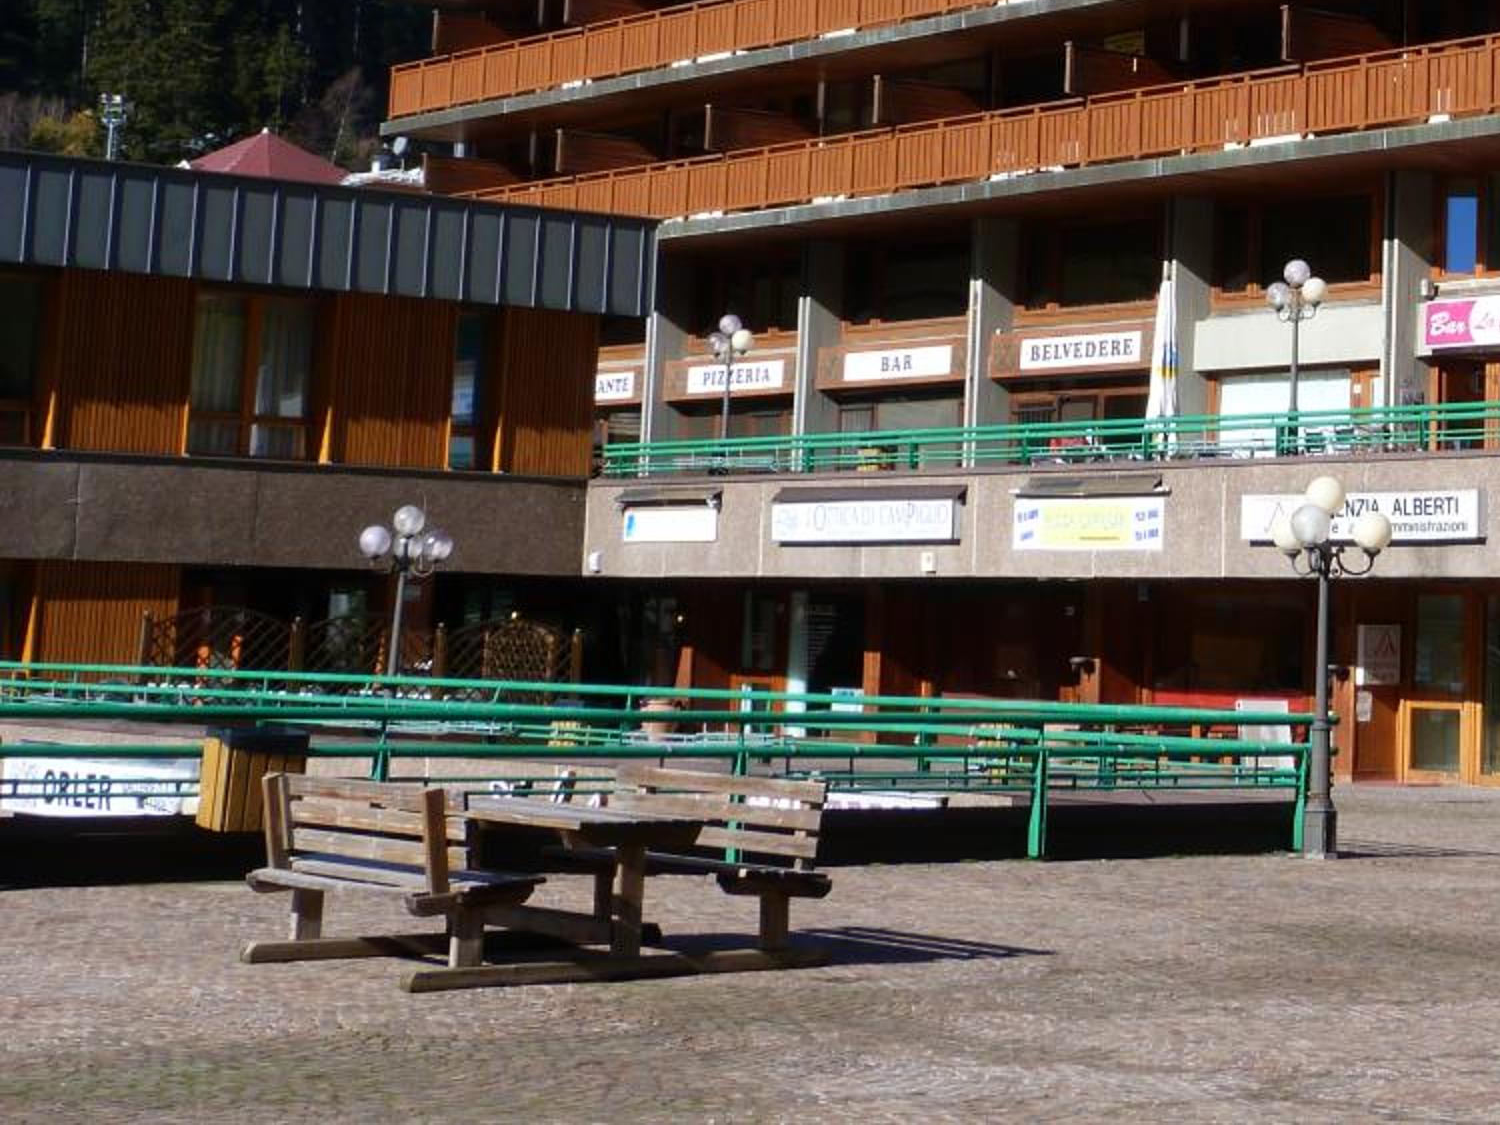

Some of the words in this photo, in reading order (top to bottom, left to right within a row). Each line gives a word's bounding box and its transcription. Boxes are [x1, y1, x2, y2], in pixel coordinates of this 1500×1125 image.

[1429, 311, 1467, 337] Bar
[1030, 338, 1134, 362] BELVEDERE
[880, 354, 913, 373] BAR
[597, 377, 630, 394] ANTE
[703, 368, 770, 387] PIZZERIA
[1392, 496, 1459, 516] ALBERTI
[1391, 520, 1469, 534] mministrazioni
[43, 768, 112, 811] ORLER
